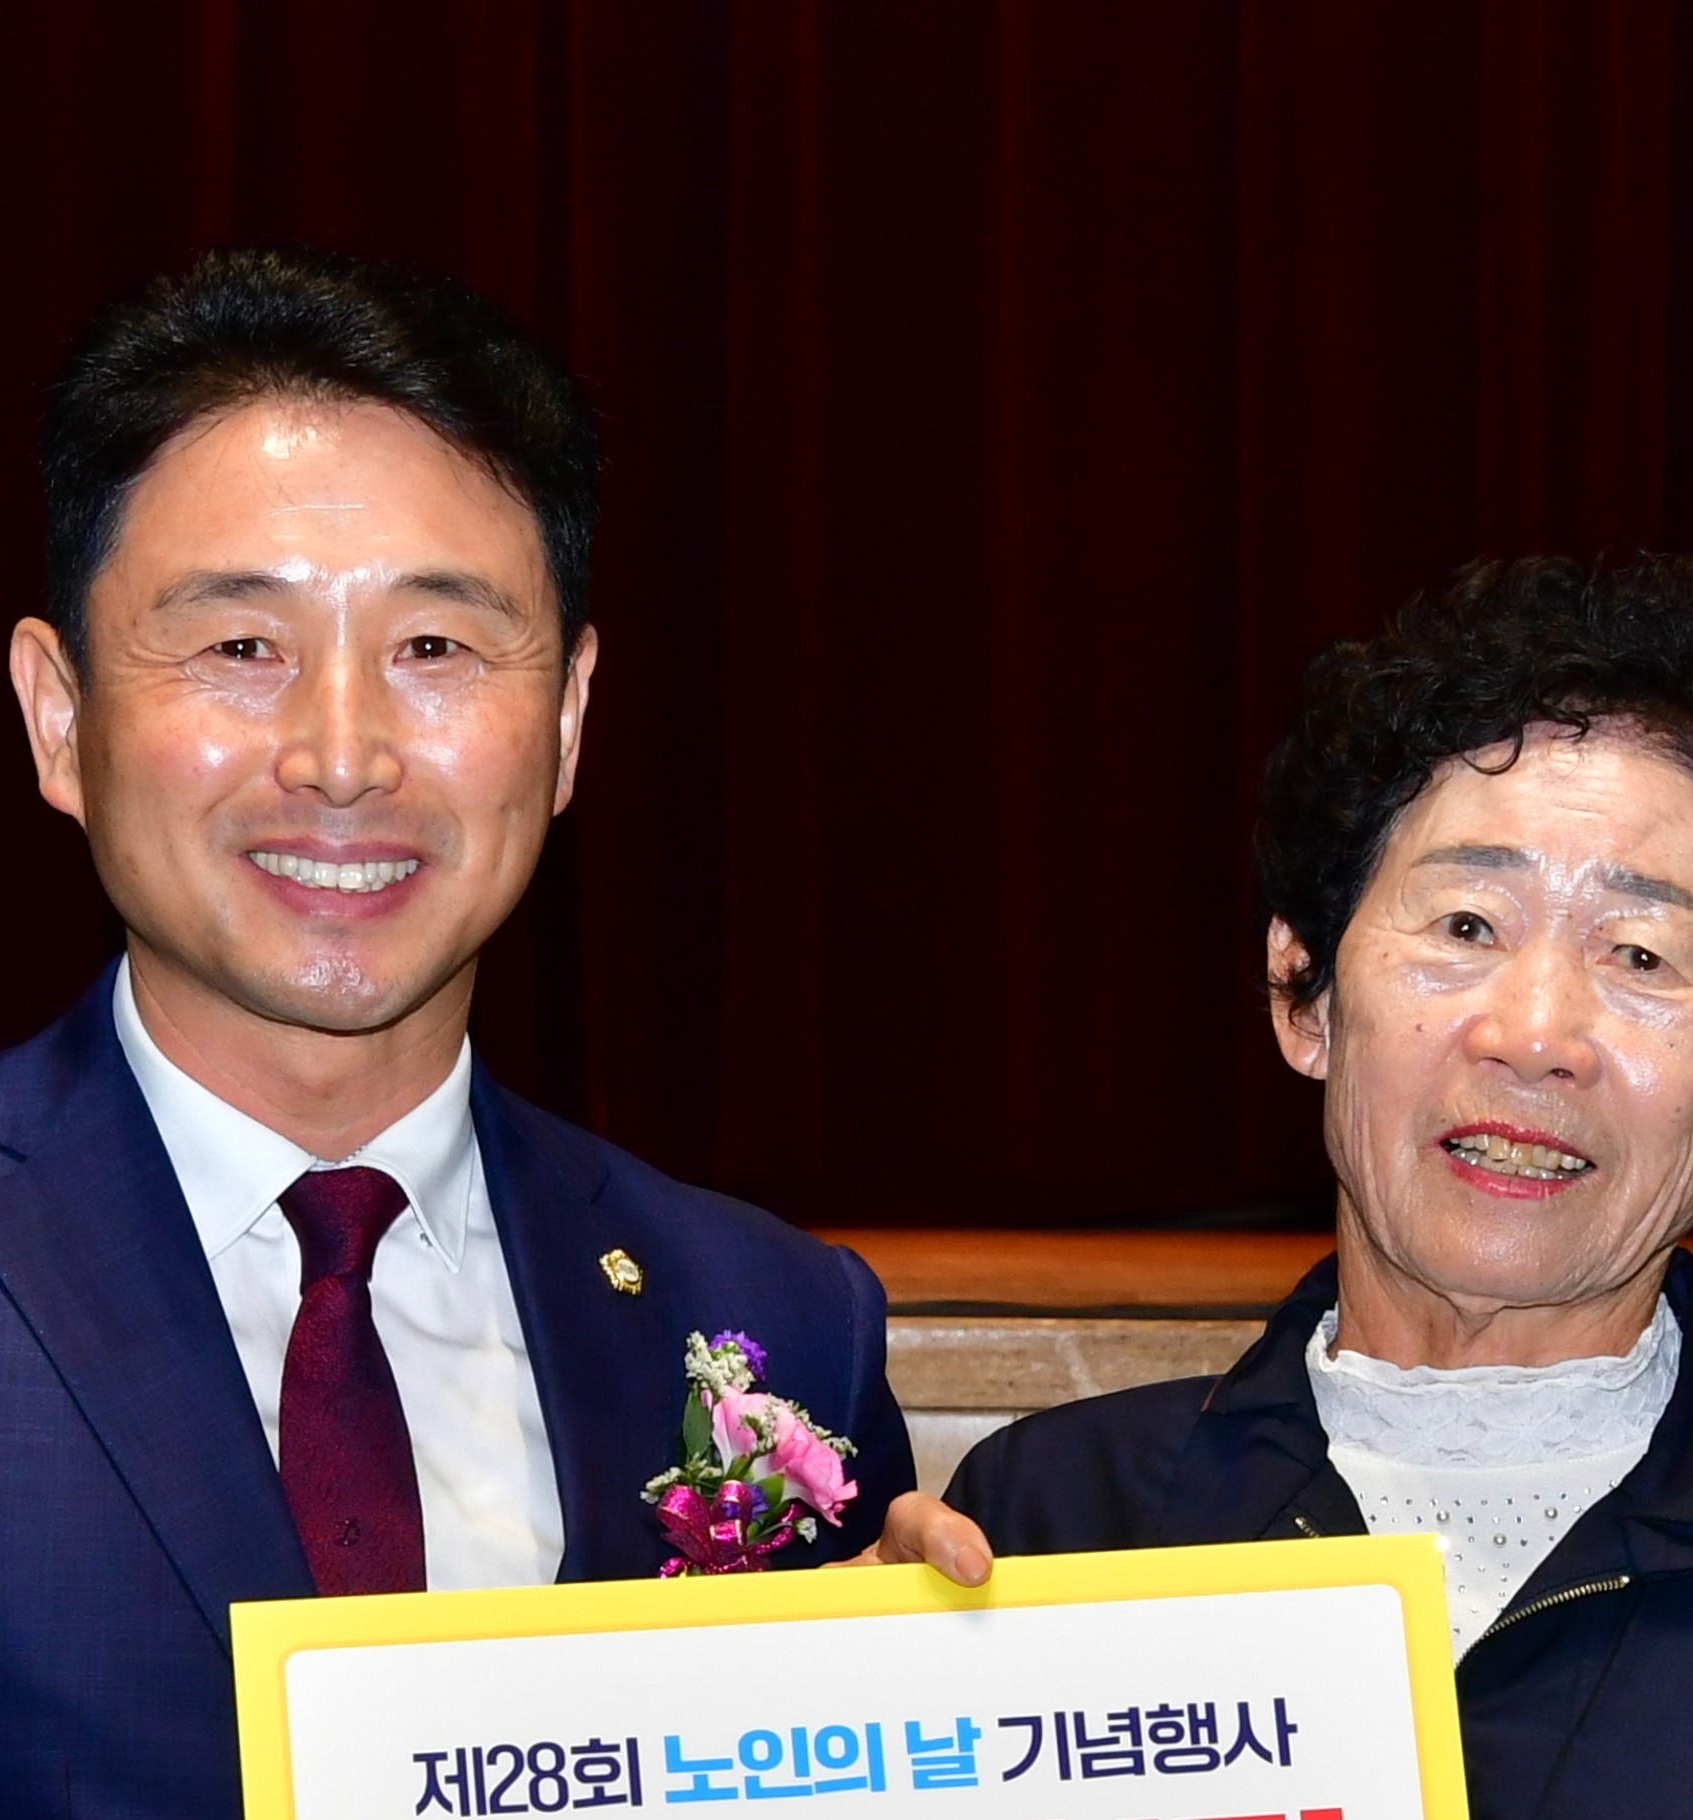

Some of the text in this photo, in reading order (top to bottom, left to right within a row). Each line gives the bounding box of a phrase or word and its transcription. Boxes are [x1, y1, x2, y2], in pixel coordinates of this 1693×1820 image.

[413, 1698, 1297, 1816] 제28회 노인의 날 기념행사
